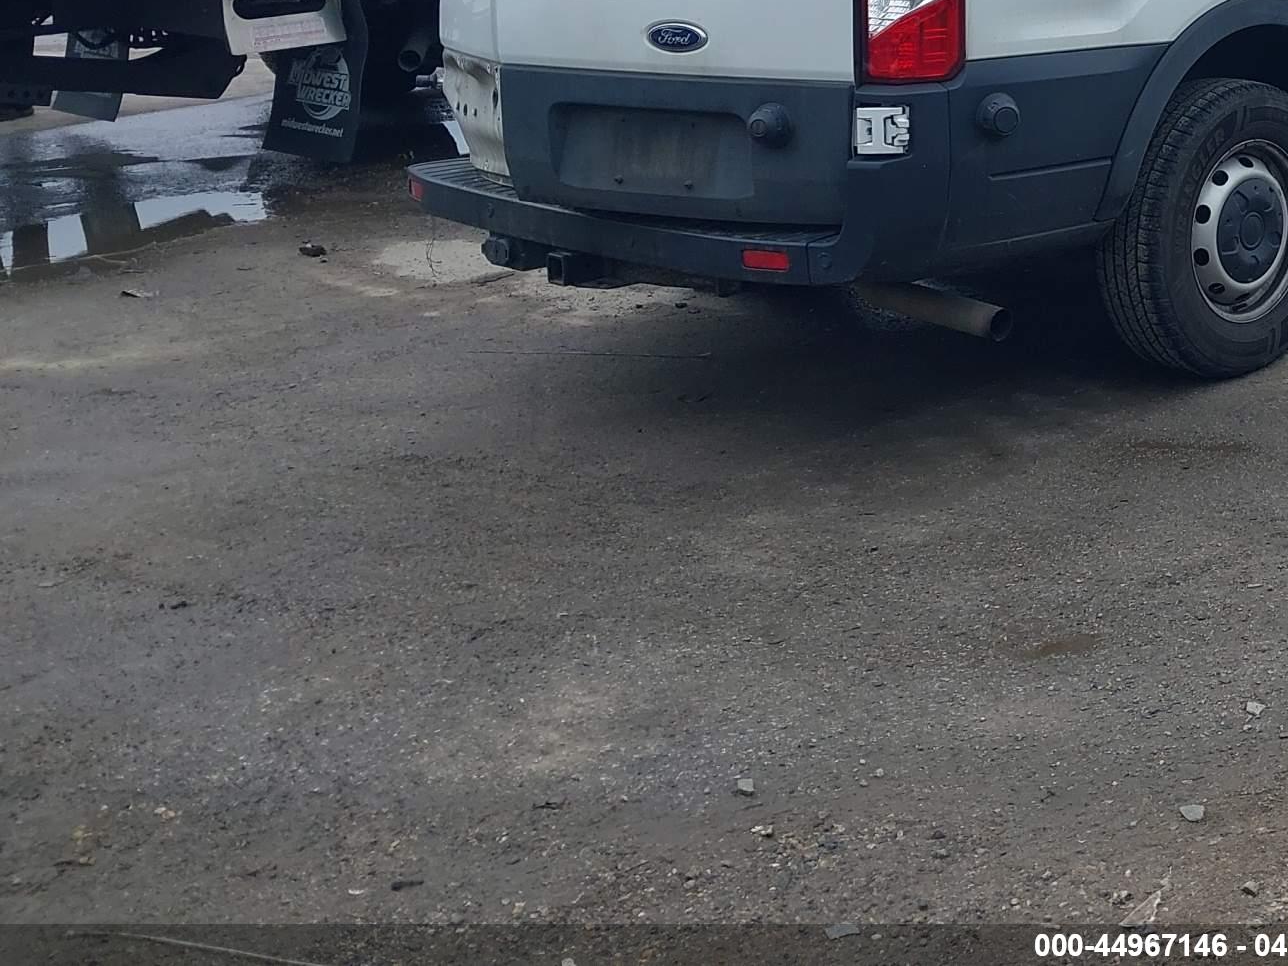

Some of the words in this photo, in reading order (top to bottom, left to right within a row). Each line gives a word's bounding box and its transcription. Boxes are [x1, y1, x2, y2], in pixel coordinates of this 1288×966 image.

[658, 28, 691, 45] Ford
[287, 59, 348, 91] MIDWEST
[296, 84, 351, 108] WRECKER
